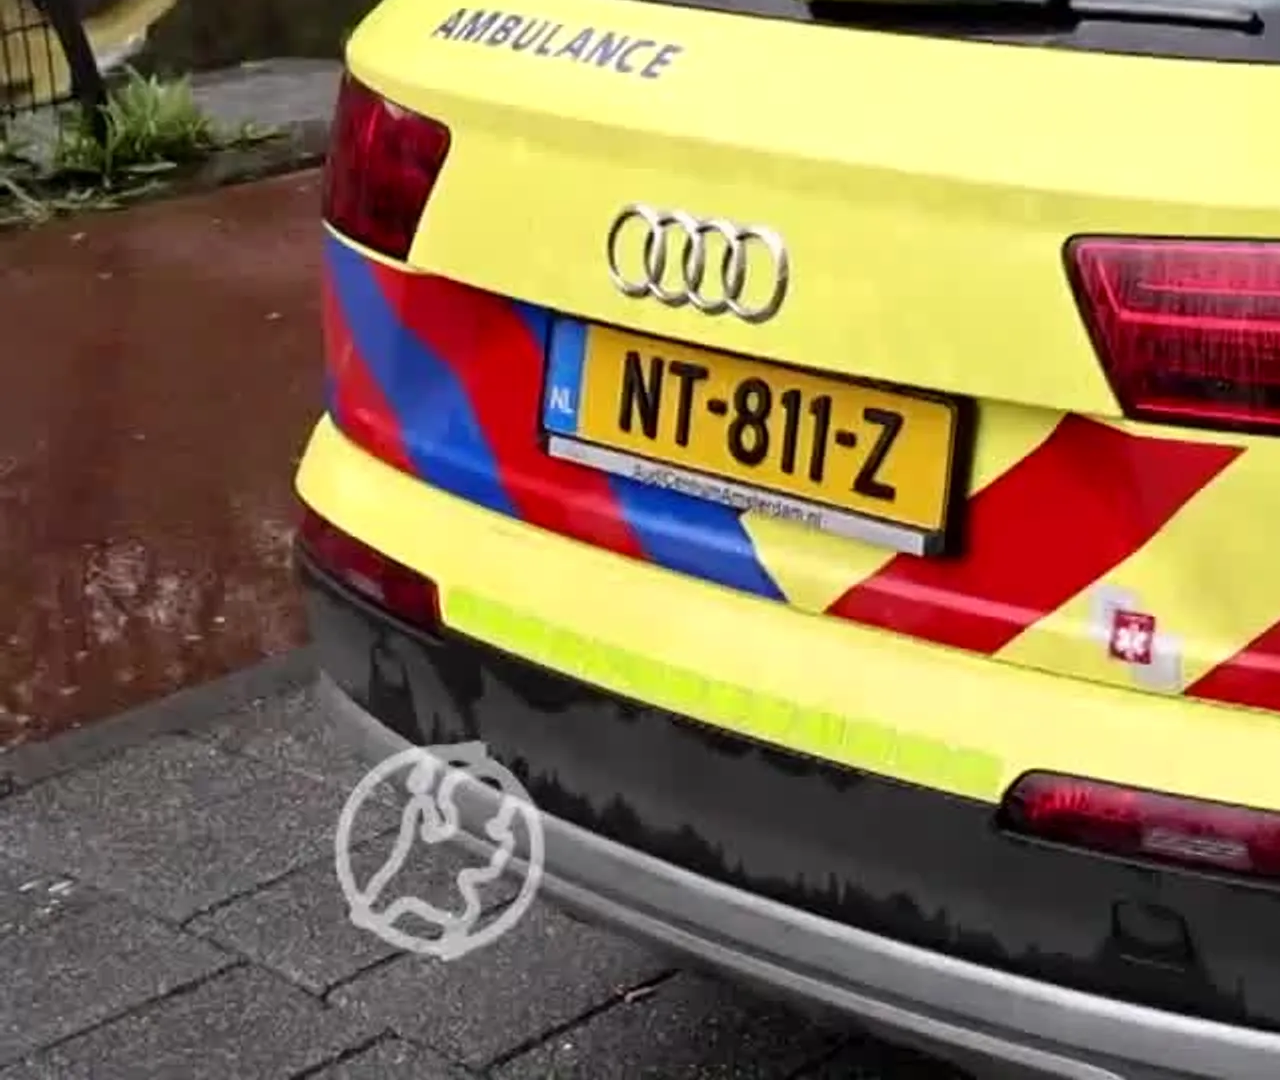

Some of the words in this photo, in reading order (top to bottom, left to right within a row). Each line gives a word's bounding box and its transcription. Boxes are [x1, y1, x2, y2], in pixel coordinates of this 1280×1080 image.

[430, 8, 684, 79] AMBULANCE
[549, 385, 575, 414] NL
[618, 350, 906, 502] NT-811-Z
